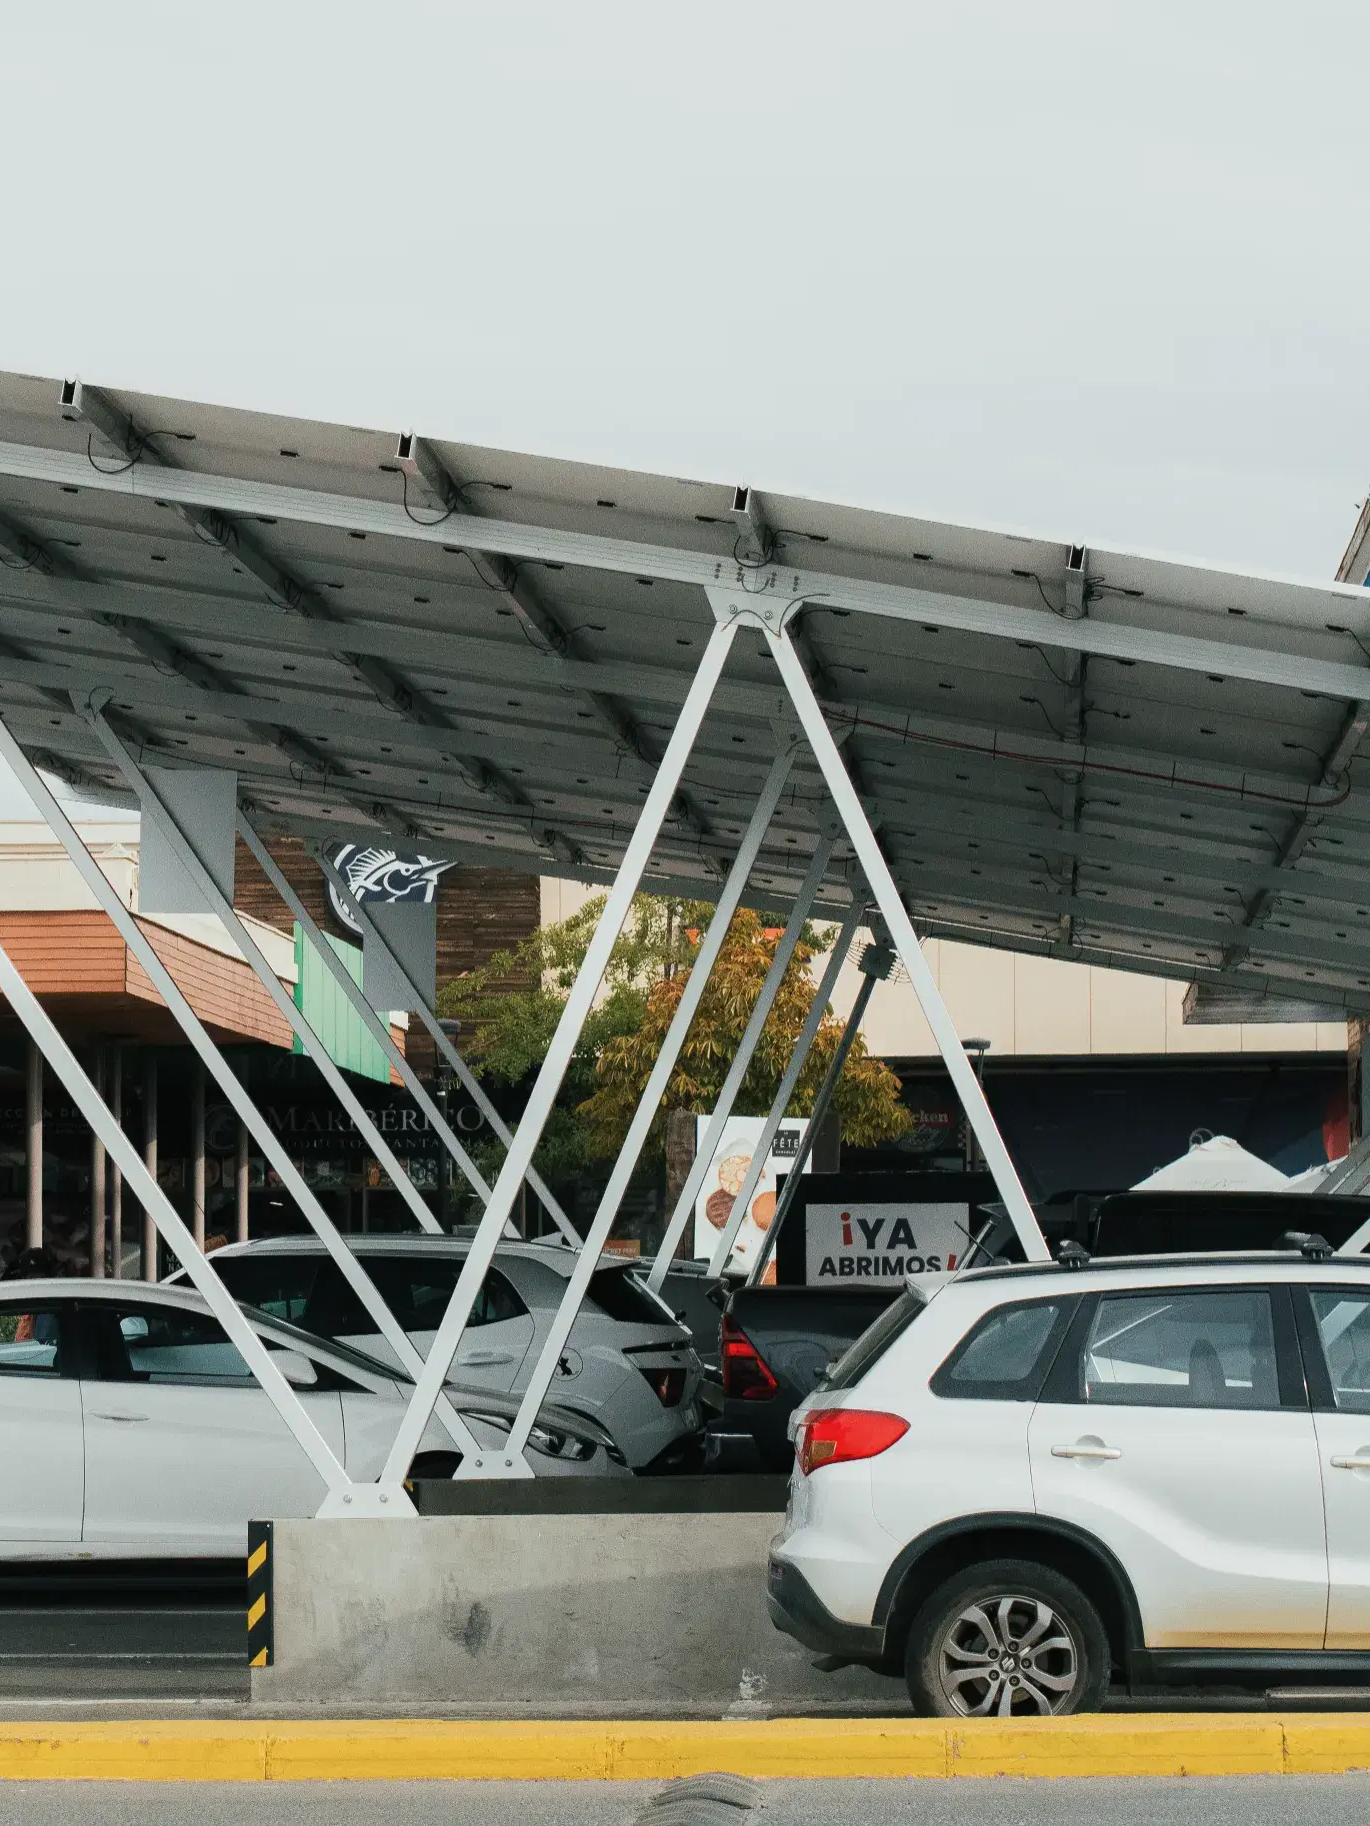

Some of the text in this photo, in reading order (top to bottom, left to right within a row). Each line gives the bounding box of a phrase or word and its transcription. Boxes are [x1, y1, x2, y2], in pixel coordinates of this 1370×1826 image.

[266, 1102, 485, 1132] MARBÉRIO
[773, 1137, 799, 1148] FÊTE
[840, 1212, 917, 1250] ¡YA
